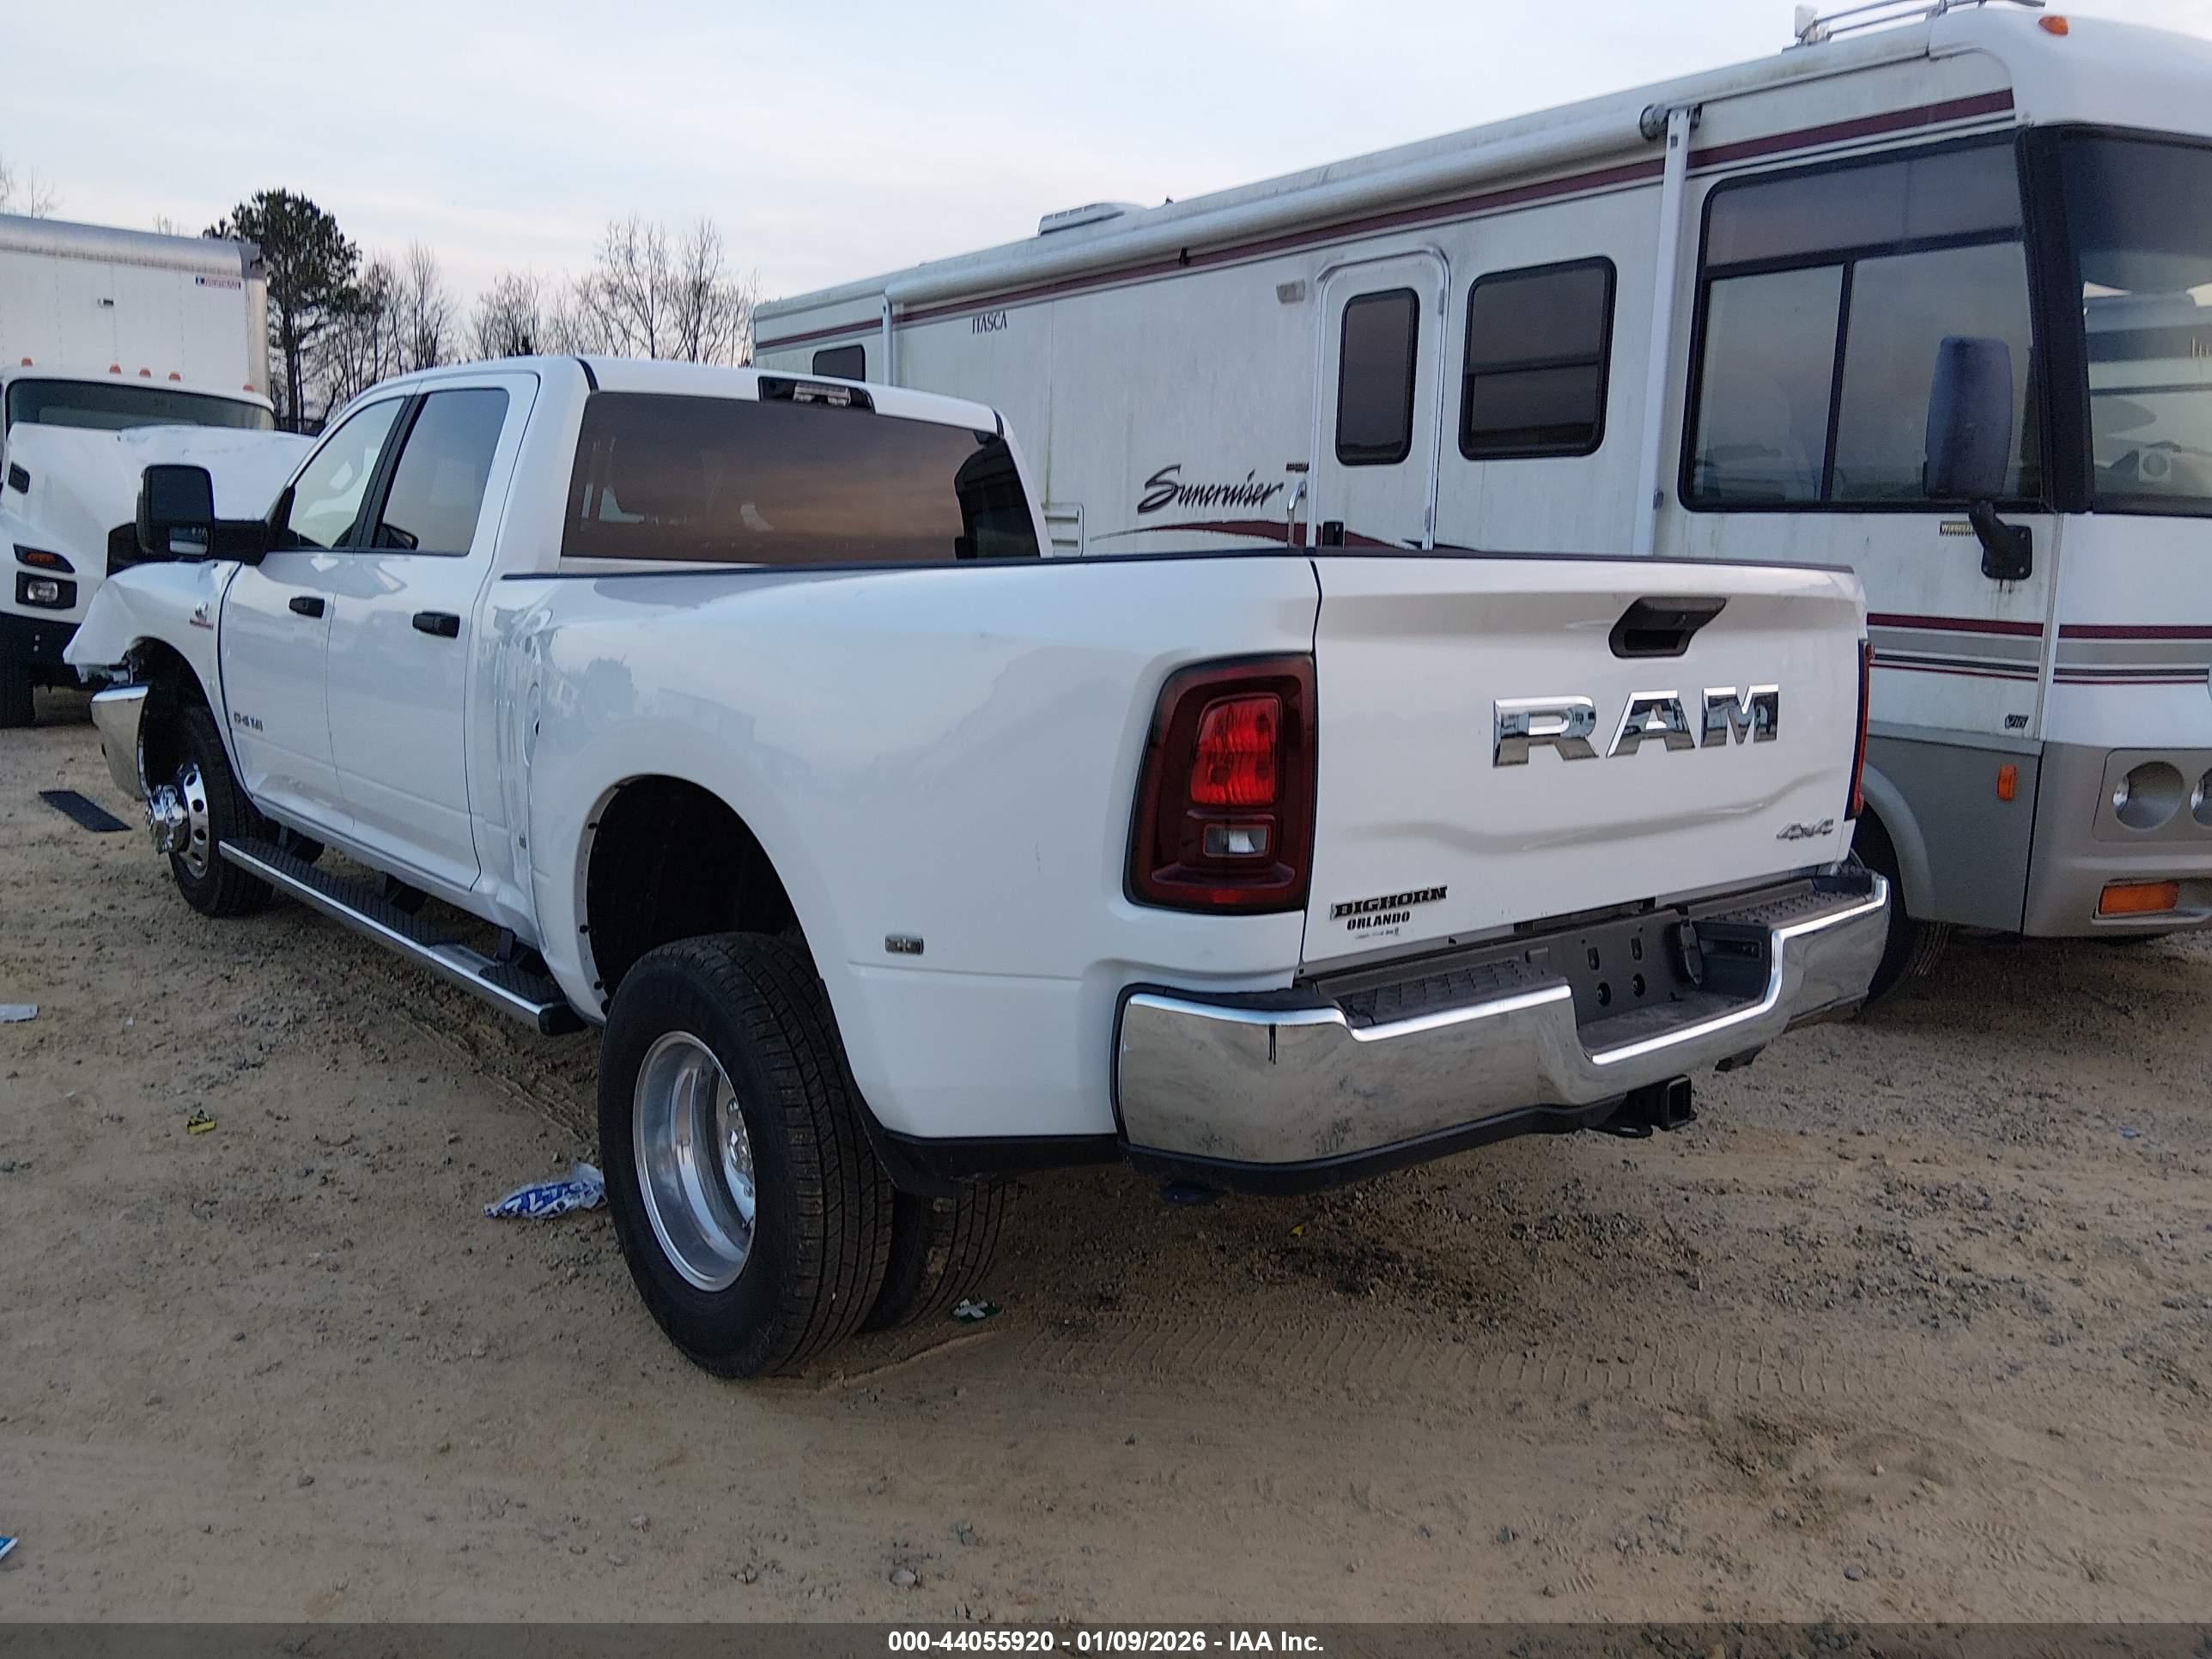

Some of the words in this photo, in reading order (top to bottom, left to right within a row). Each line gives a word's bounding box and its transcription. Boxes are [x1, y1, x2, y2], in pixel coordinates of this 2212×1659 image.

[971, 312, 1007, 335] ITASCA
[1137, 463, 1285, 515] Suncruiser
[1492, 684, 1780, 768] RAM
[1346, 910, 1411, 931] ORLANDO
